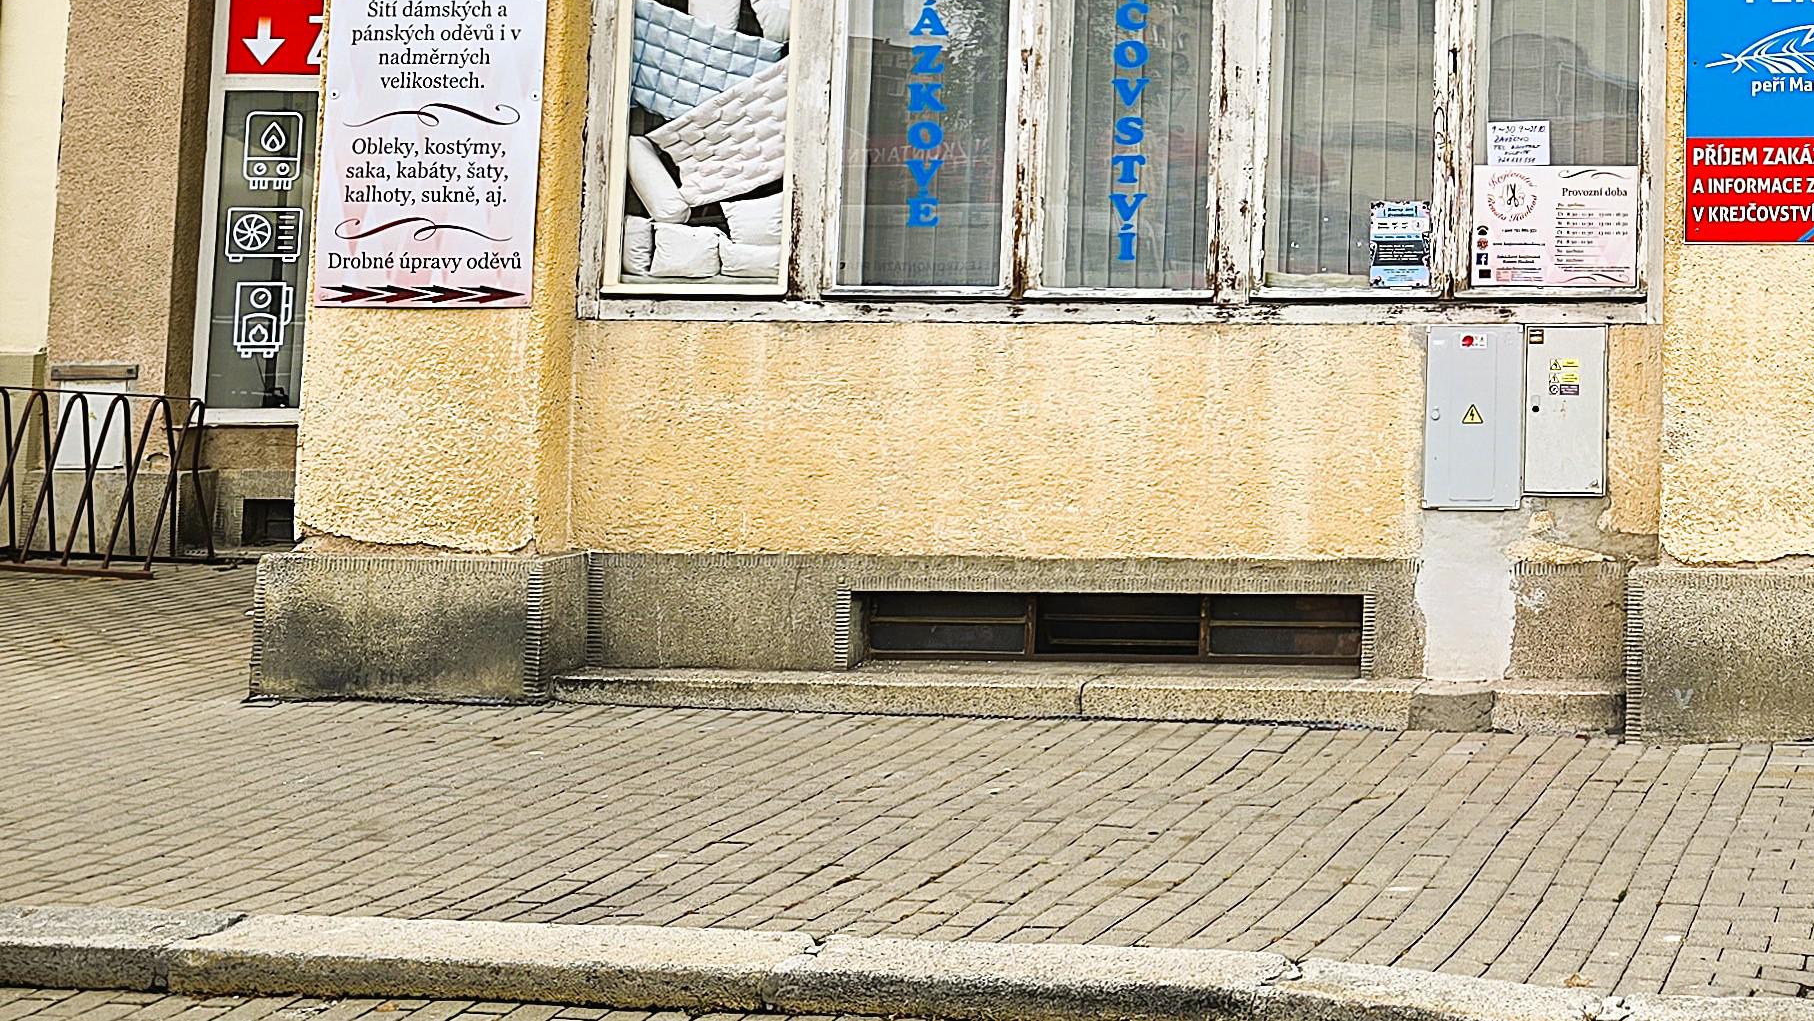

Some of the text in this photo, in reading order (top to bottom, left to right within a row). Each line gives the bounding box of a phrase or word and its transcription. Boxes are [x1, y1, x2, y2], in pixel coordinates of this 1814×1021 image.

[402, 0, 492, 24] dámských
[497, 4, 508, 18] a
[351, 23, 522, 46] pánských oděvů i v
[378, 48, 491, 69] nadměrných
[380, 72, 485, 90] velikostech.
[1751, 77, 1787, 97] peří
[351, 137, 507, 159] Obleky, kostýmy,
[1692, 143, 1758, 166] PŘÍJEM
[345, 162, 509, 183] saka, kabáty, šaty,
[344, 185, 507, 207] kalhoty, sukně, aj.
[1561, 187, 1628, 196] Provozní doba
[1692, 178, 1704, 194] A
[1708, 178, 1803, 194] INFORMACE
[1692, 206, 1704, 222] V
[327, 252, 522, 274] Drobné úpravy oděvů
